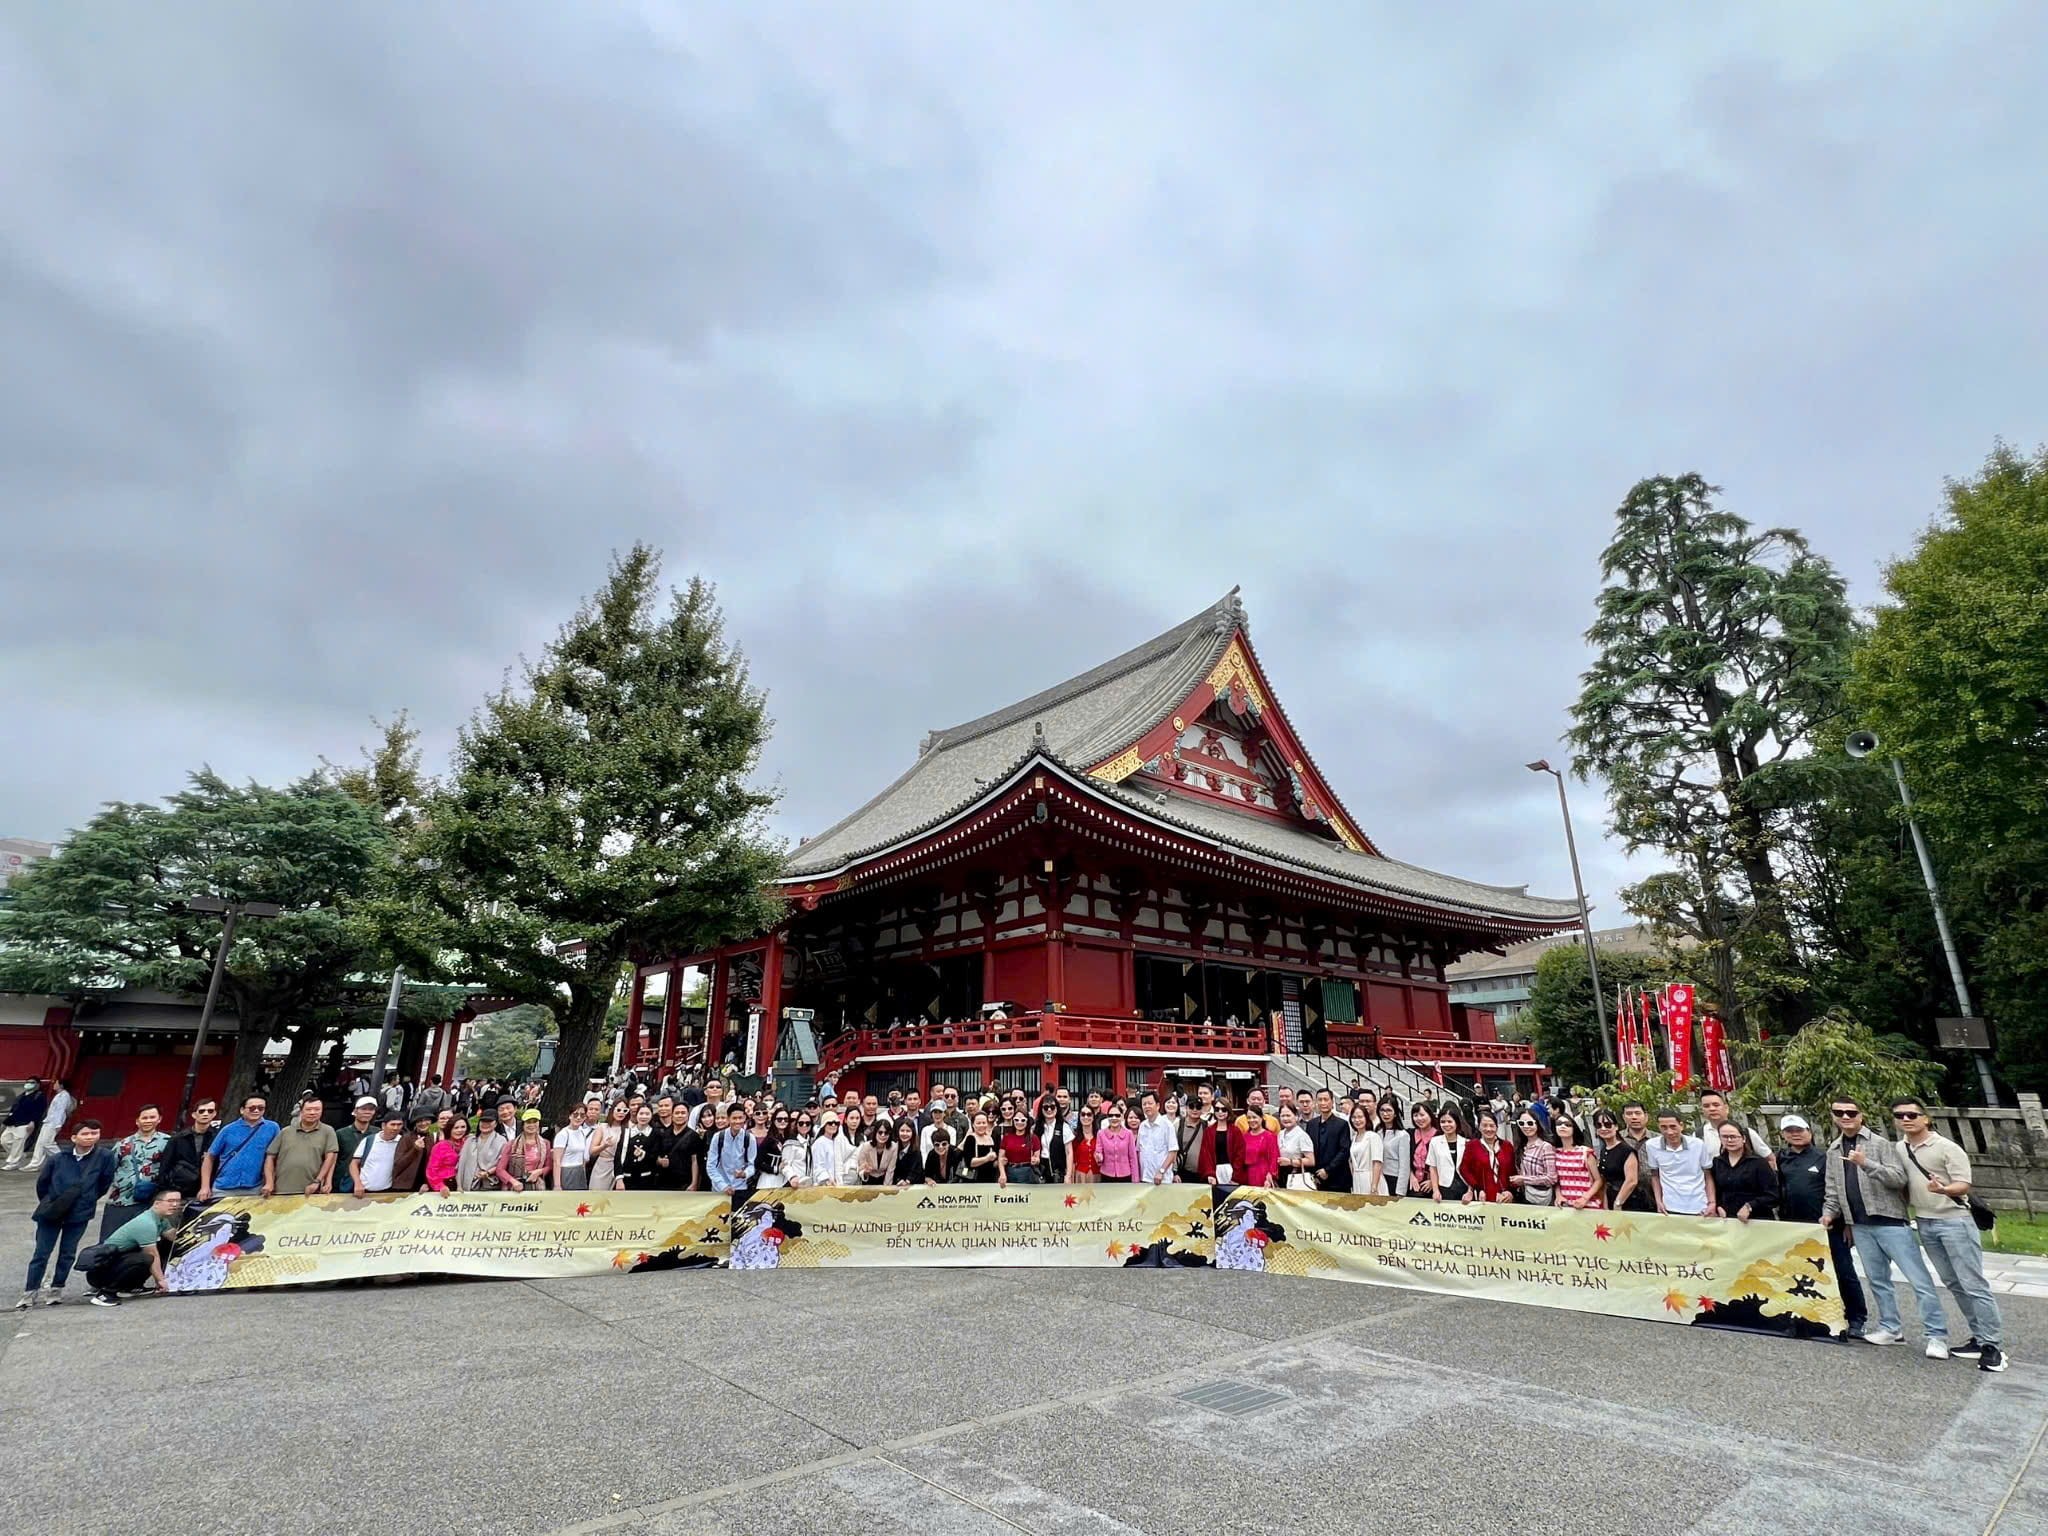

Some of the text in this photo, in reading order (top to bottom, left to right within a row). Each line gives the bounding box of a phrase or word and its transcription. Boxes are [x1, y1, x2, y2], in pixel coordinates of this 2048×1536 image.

[994, 1194, 1029, 1204] Funiki
[499, 1202, 539, 1213] Funiki
[1015, 1222, 1041, 1233] KHU
[1500, 1216, 1546, 1230] Funiki
[517, 1230, 547, 1242] KHU
[915, 1237, 955, 1249] THAM
[961, 1237, 997, 1250] QUAN
[398, 1244, 445, 1256] THAM
[451, 1247, 493, 1259] QUAN
[1532, 1251, 1567, 1267] KHU
[1411, 1258, 1460, 1275] THAM
[1466, 1263, 1511, 1280] QUAN
